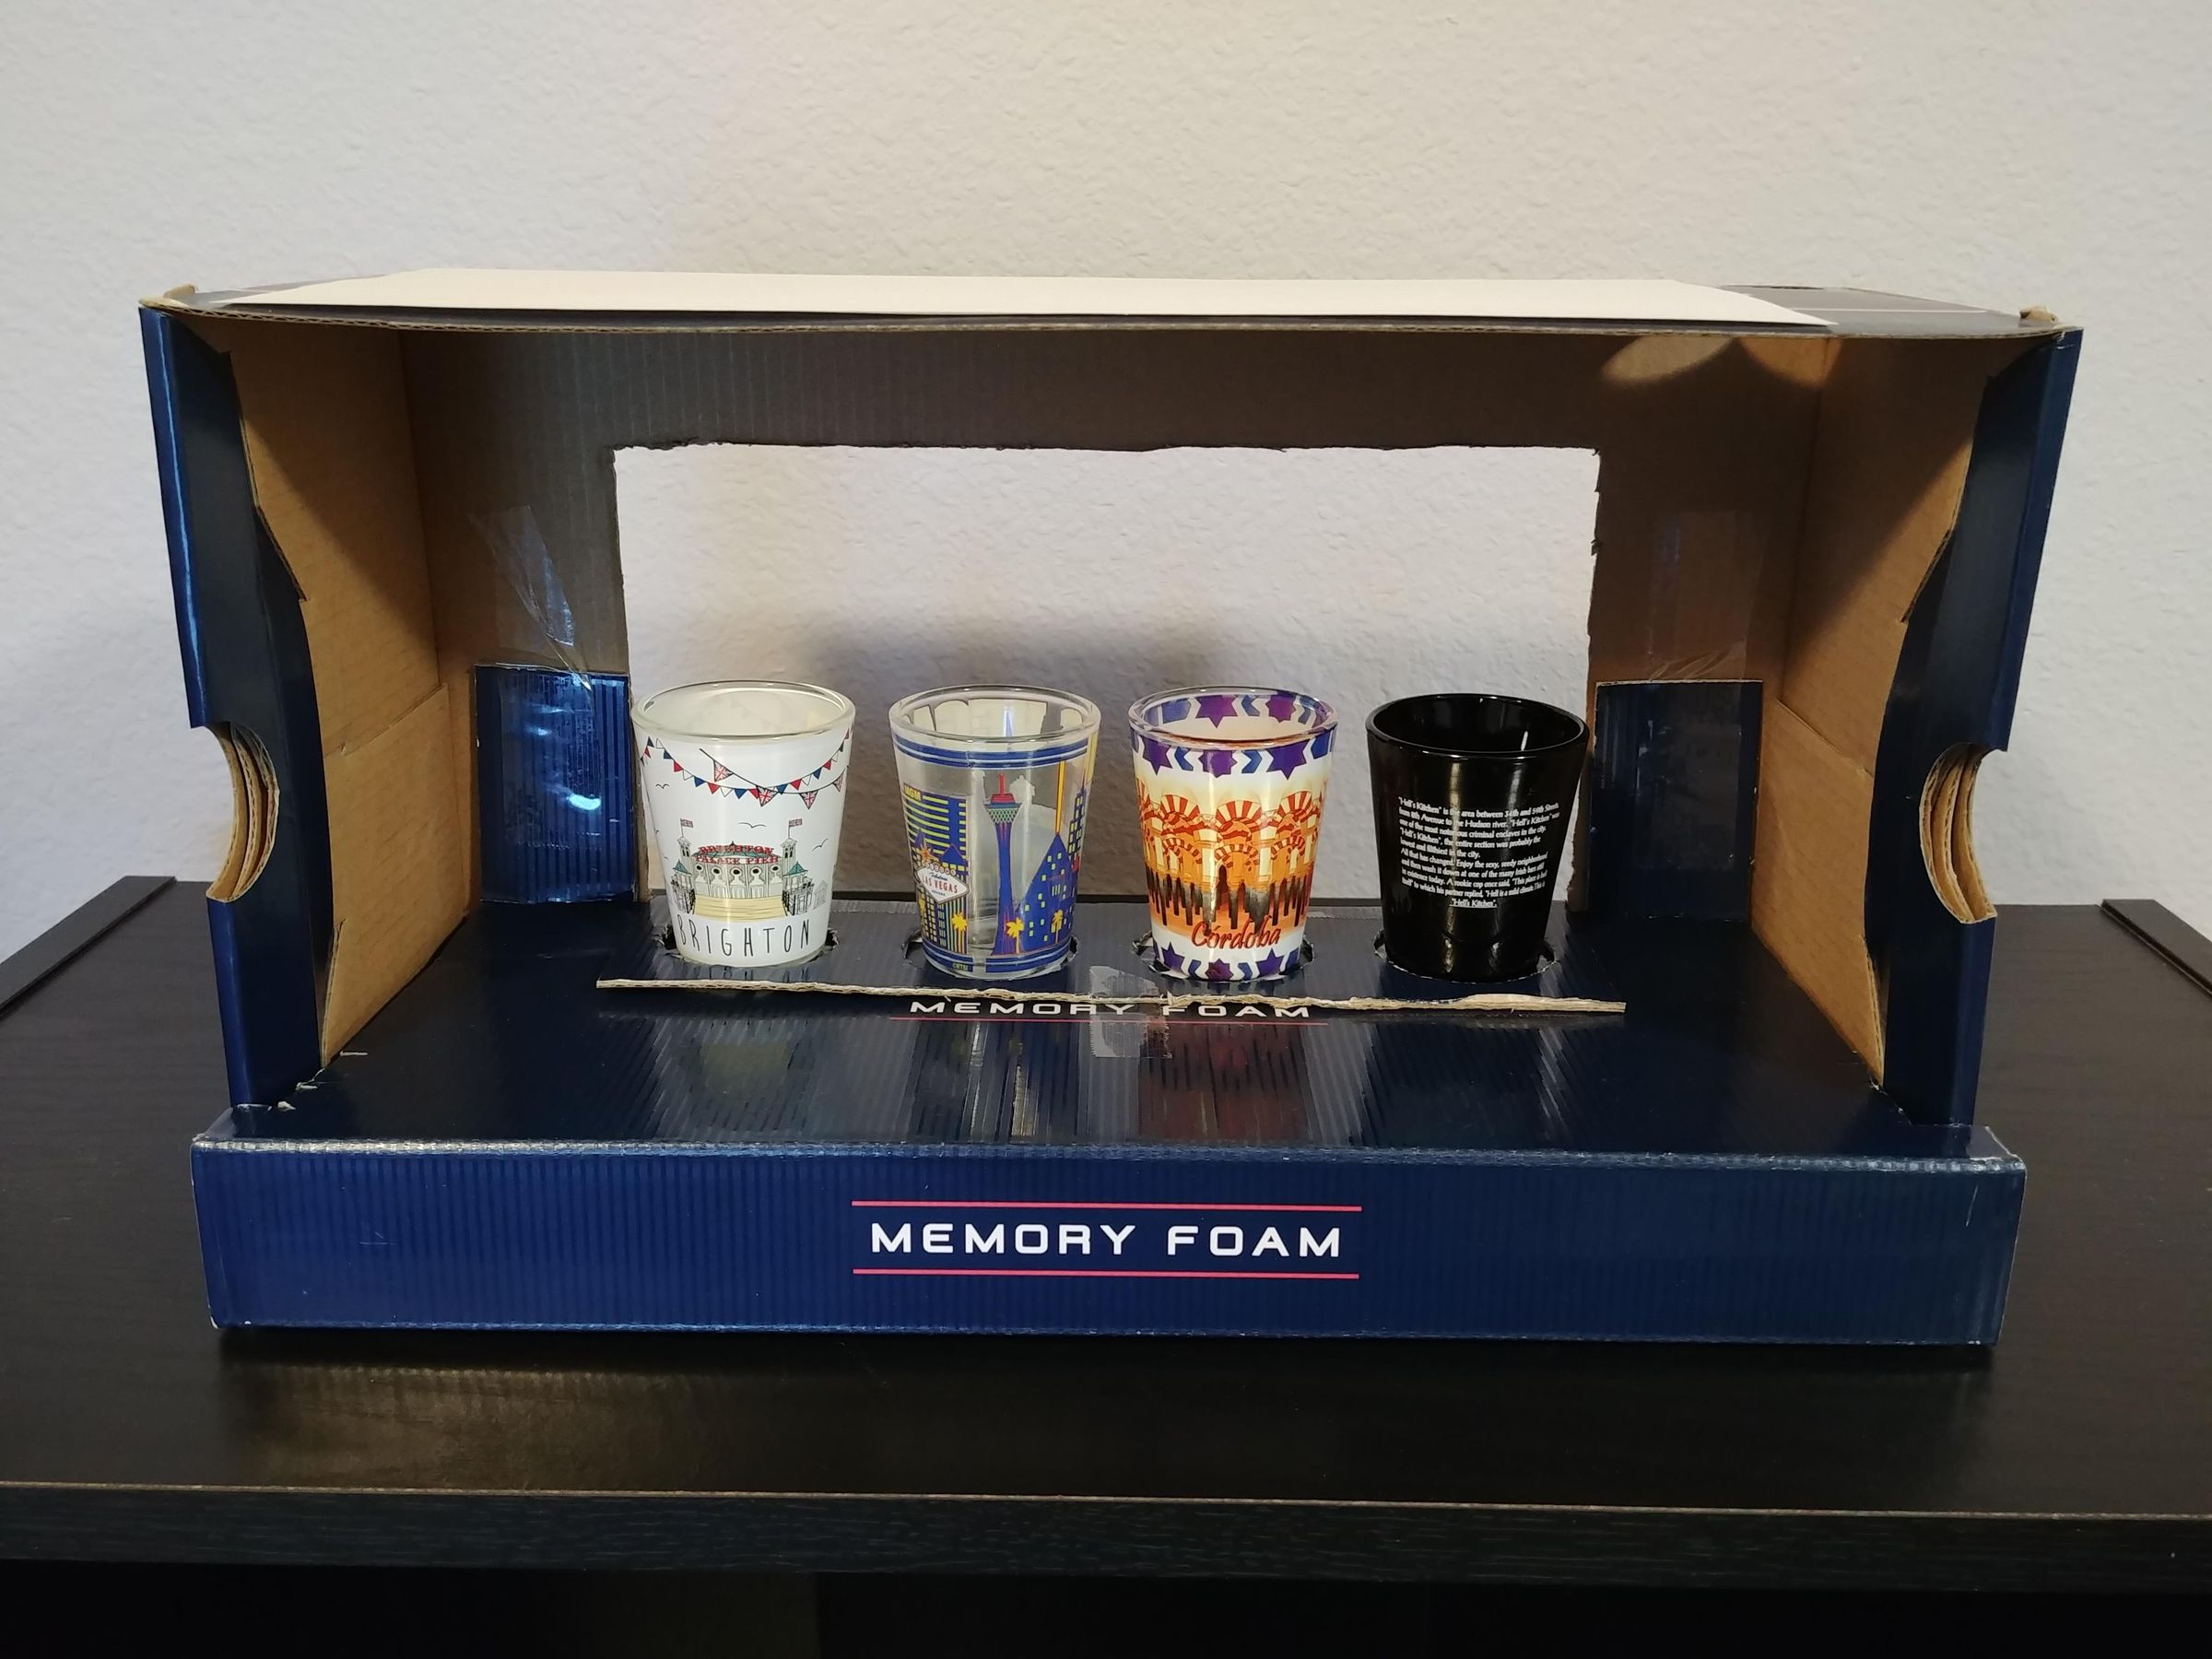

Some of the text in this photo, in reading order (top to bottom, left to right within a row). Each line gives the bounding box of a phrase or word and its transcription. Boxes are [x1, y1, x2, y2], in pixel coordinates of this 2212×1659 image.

[1399, 806, 1410, 818] from
[1421, 813, 1445, 824] Avenue
[1445, 818, 1453, 826] to
[1465, 819, 1491, 828] Hudson
[1476, 809, 1504, 818] between
[1504, 808, 1519, 818] 34th
[1520, 807, 1532, 817] and
[1532, 806, 1545, 815] 59th
[1399, 818, 1408, 827] one
[1408, 820, 1415, 829] of
[1415, 821, 1424, 830] the
[1425, 825, 1439, 834] most
[1469, 830, 1495, 839] criminal
[1496, 830, 1520, 839] enclaves
[1528, 827, 1536, 835] the
[1401, 836, 1481, 860] lowest and filthiest in the city.
[1444, 837, 1454, 846] the
[1455, 840, 1473, 848] entire
[1509, 837, 1533, 849] probably
[1533, 835, 1541, 843] the
[694, 854, 781, 865] PALACE PIER
[1401, 847, 1409, 856] All
[1409, 850, 1419, 859] that
[1419, 852, 1429, 862] has
[1456, 859, 1474, 869] Enjoy
[1475, 860, 1485, 868] the
[1500, 858, 1517, 868] seedy
[1517, 851, 1548, 866] neighborhood
[1401, 858, 1410, 866] and
[1410, 860, 1421, 870] then
[1421, 865, 1437, 874] wash
[1438, 866, 1442, 875] it
[1442, 867, 1460, 877] down
[1488, 870, 1499, 878] the
[1499, 870, 1514, 878] many
[1515, 866, 1527, 877] Irish
[1527, 865, 1536, 874] bars
[922, 875, 933, 887] LAS
[934, 879, 959, 894] VEGAS
[1401, 866, 1406, 875] in
[1406, 870, 1429, 882] existence
[1429, 875, 1446, 886] today.
[1446, 877, 1454, 886] A
[1454, 878, 1472, 888] rookie
[1473, 881, 1484, 889] cop
[1512, 877, 1525, 886] "This
[1525, 875, 1536, 885] place
[1419, 882, 1436, 893] which
[1436, 885, 1444, 894] his
[1444, 888, 1464, 897] partner
[1485, 889, 1500, 898] "Hell
[1509, 887, 1520, 896] mild
[677, 913, 810, 958] BRIGHTON
[1191, 915, 1281, 950] Córdoba
[910, 1001, 1310, 1018] MEMORY FOAM
[871, 1222, 1341, 1258] MEMORY FOAM
